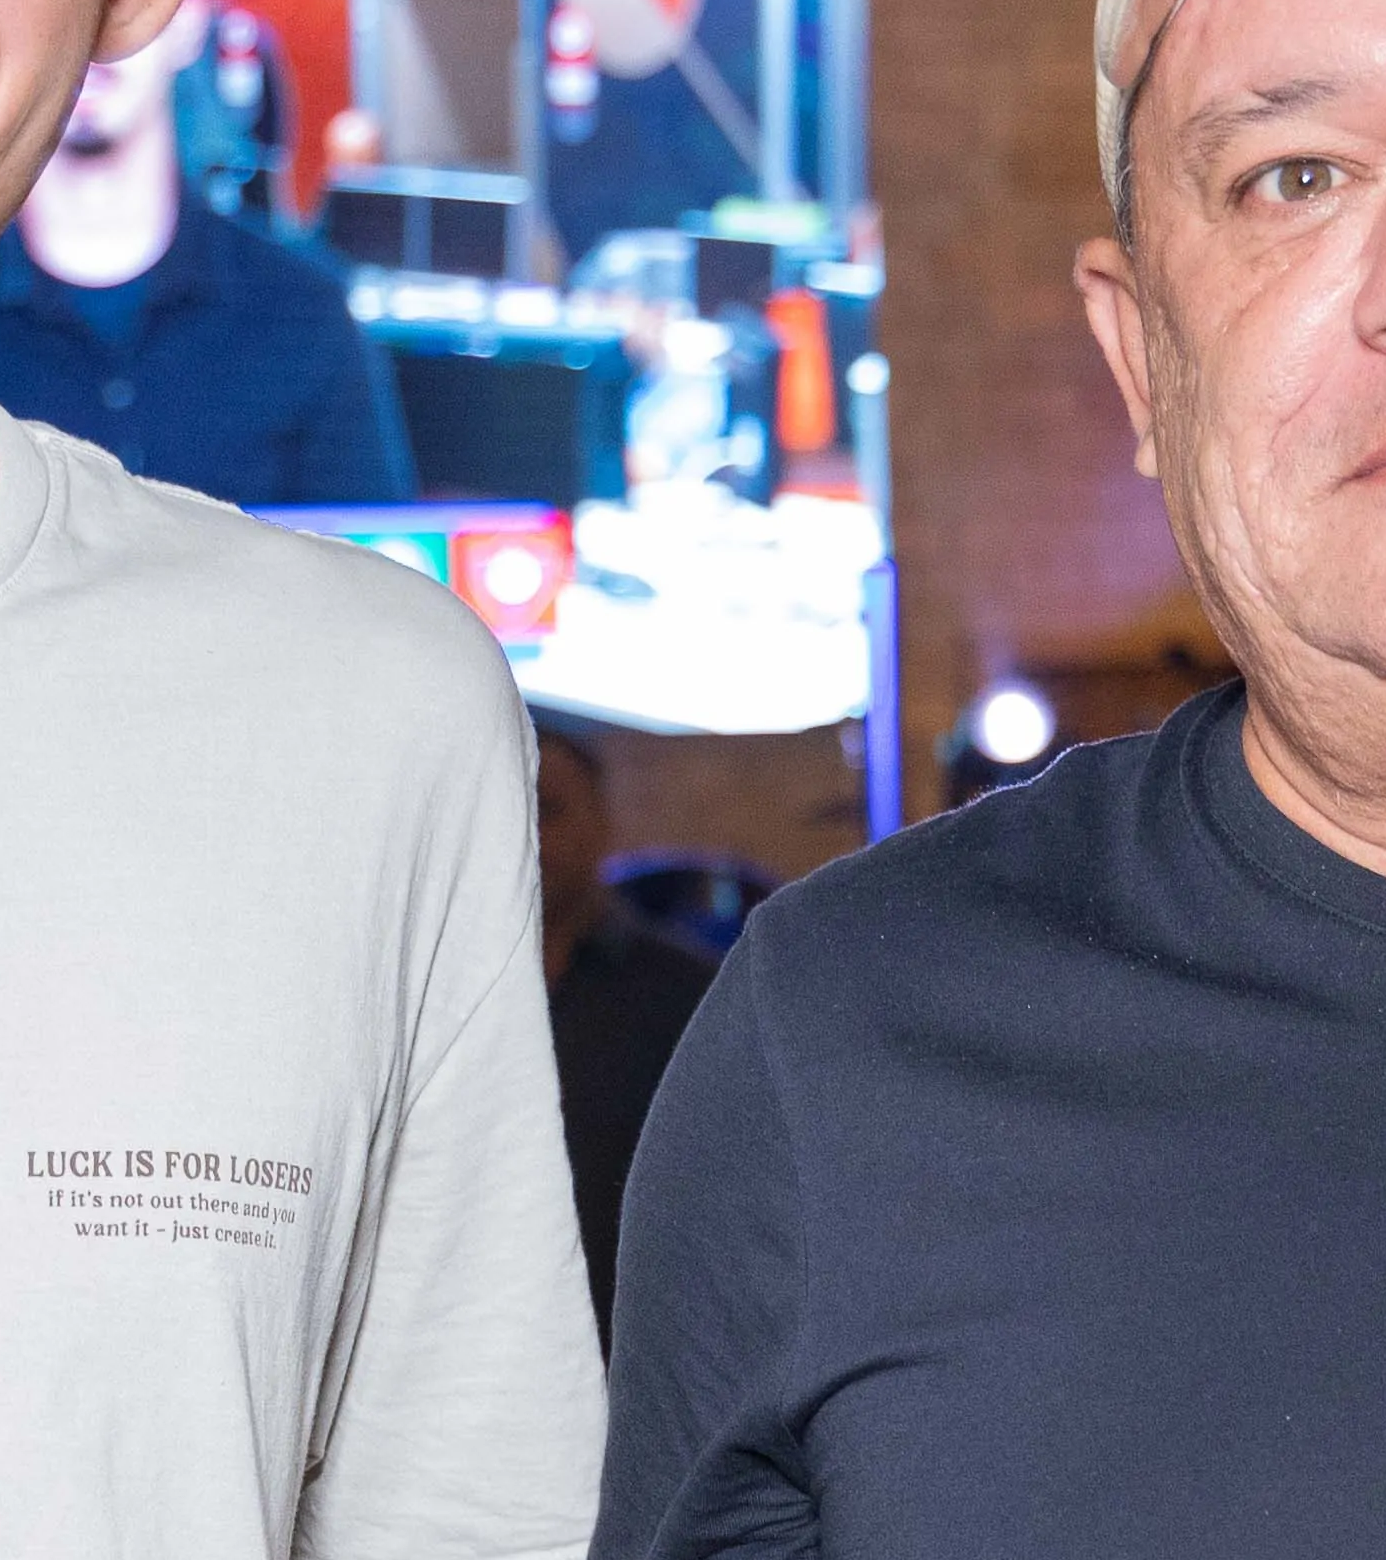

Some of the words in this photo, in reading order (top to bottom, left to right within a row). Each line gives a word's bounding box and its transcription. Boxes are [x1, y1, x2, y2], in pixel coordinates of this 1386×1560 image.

[27, 1150, 113, 1178] LUCK
[124, 1150, 155, 1178] IS
[165, 1151, 221, 1182] FOR
[230, 1155, 313, 1196] LOSERS
[48, 1189, 64, 1207] if
[71, 1189, 103, 1208] it's
[110, 1192, 144, 1209] not
[150, 1194, 183, 1209] out
[190, 1192, 239, 1215] there
[243, 1201, 270, 1219] and
[272, 1206, 295, 1225] you
[74, 1221, 128, 1237] want
[135, 1219, 149, 1237] it
[172, 1219, 209, 1243] just
[215, 1227, 261, 1247] create
[264, 1230, 277, 1249] it.
